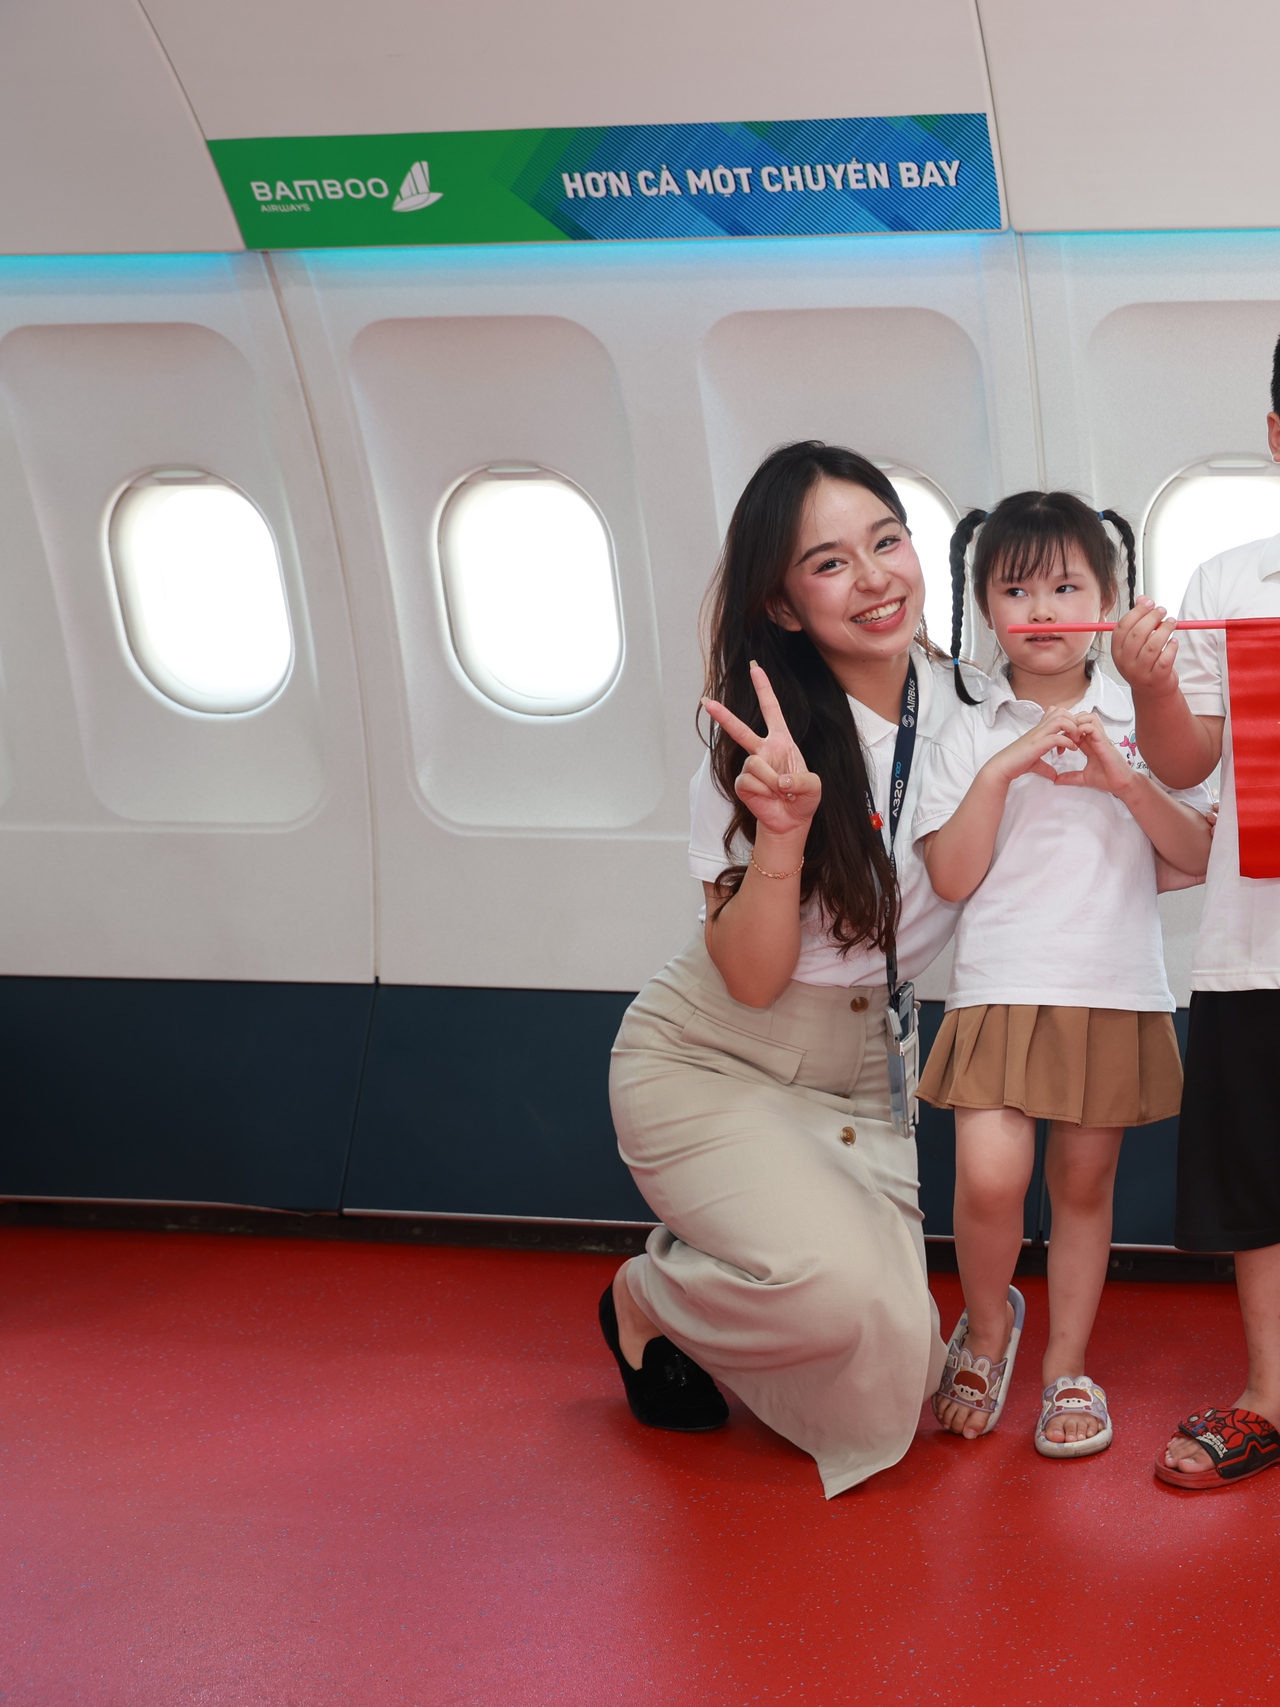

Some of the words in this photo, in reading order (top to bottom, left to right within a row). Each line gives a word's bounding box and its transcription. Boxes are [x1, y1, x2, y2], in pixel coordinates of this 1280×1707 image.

[250, 178, 389, 202] BAMBOO
[561, 170, 633, 199] HƠN
[637, 164, 683, 197] CẢ
[686, 164, 753, 198] MỘT
[899, 160, 961, 189] BAY
[260, 203, 311, 213] AIRWAYS
[906, 678, 916, 713] AIRBUS
[893, 779, 904, 818] A320
